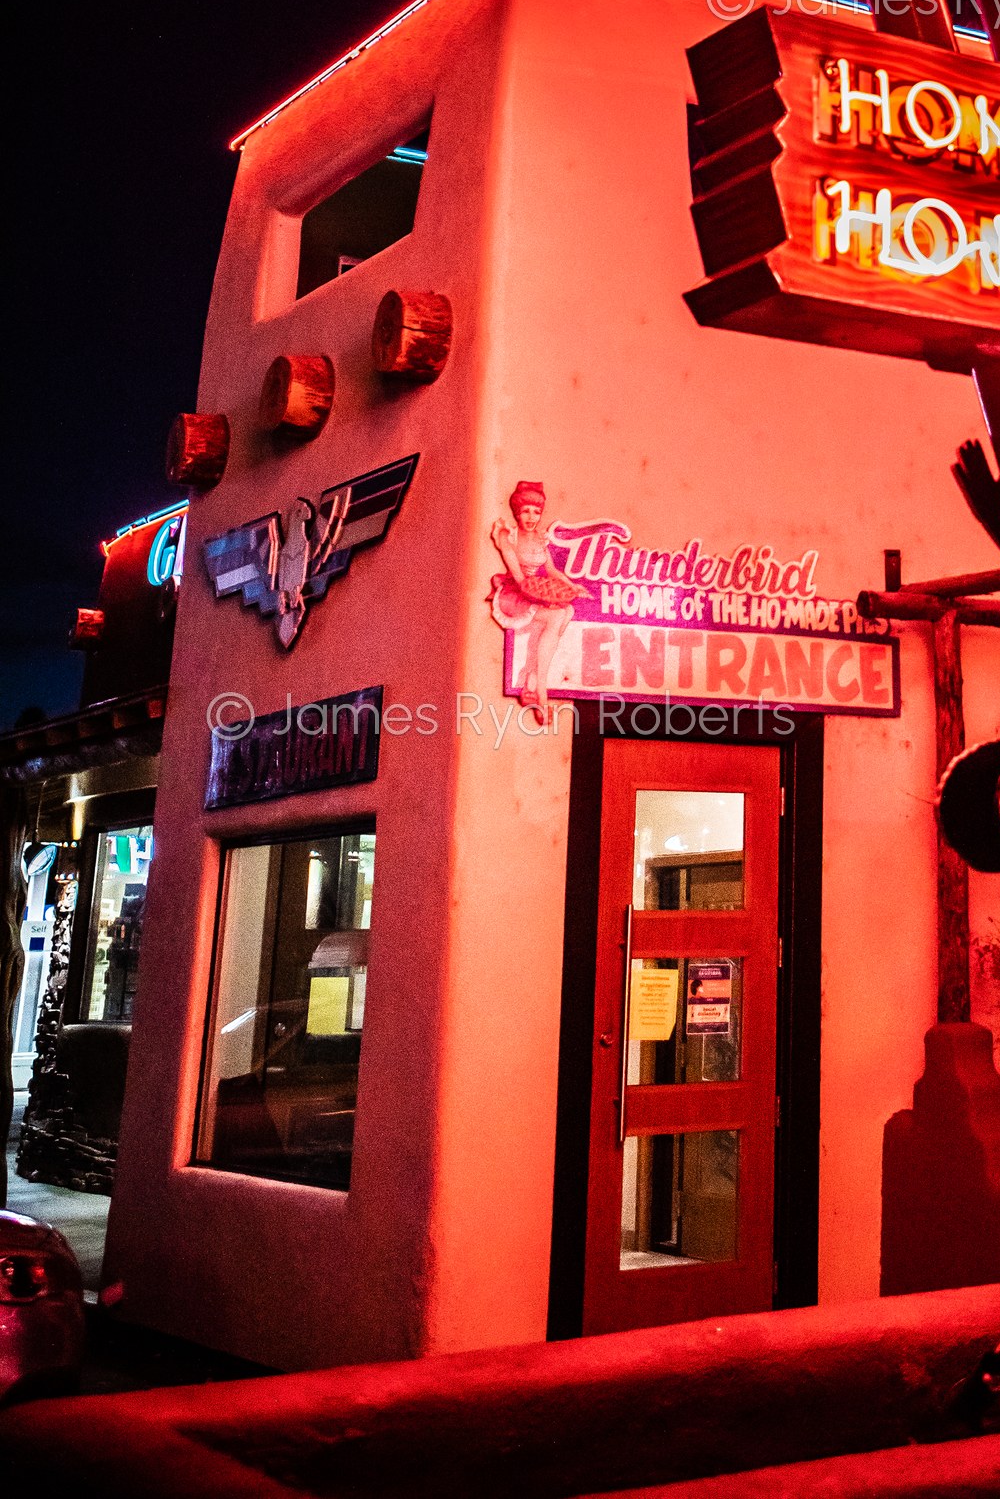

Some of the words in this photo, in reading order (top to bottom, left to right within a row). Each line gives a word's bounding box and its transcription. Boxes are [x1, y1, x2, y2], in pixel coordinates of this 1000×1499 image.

[549, 519, 819, 599] Thunderbird
[600, 583, 677, 621] HOME
[708, 591, 750, 626] THE
[580, 625, 893, 705] ENTRANCE
[214, 696, 378, 800] STAURANT
[31, 925, 47, 933] Self
